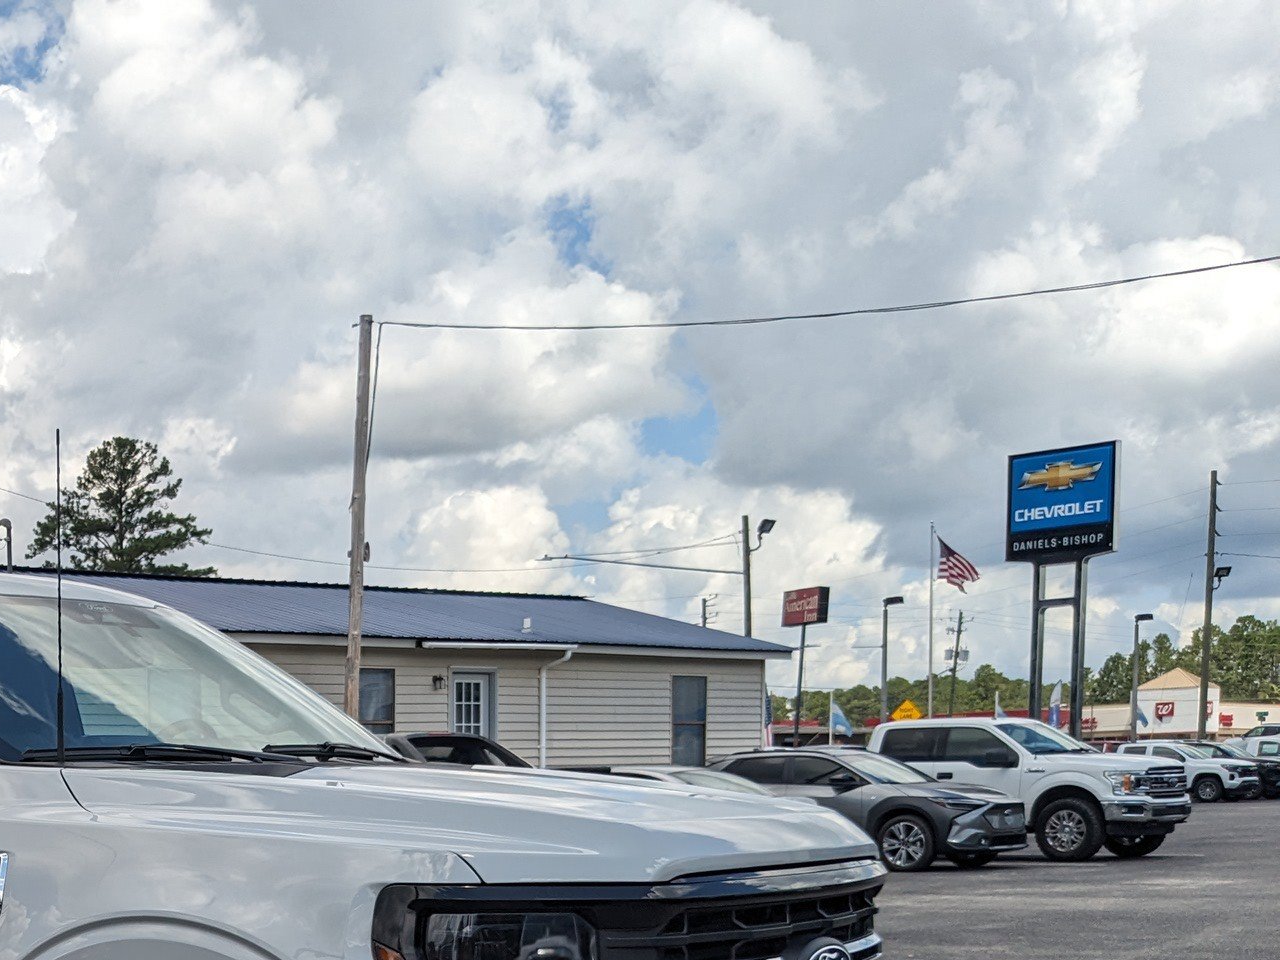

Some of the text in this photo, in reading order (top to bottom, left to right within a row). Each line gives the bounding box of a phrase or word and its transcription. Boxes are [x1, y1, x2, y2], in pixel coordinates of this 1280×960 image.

[1014, 499, 1104, 523] CHEVROLET
[1012, 533, 1105, 552] DANIELS-BISHOP
[785, 595, 819, 613] American
